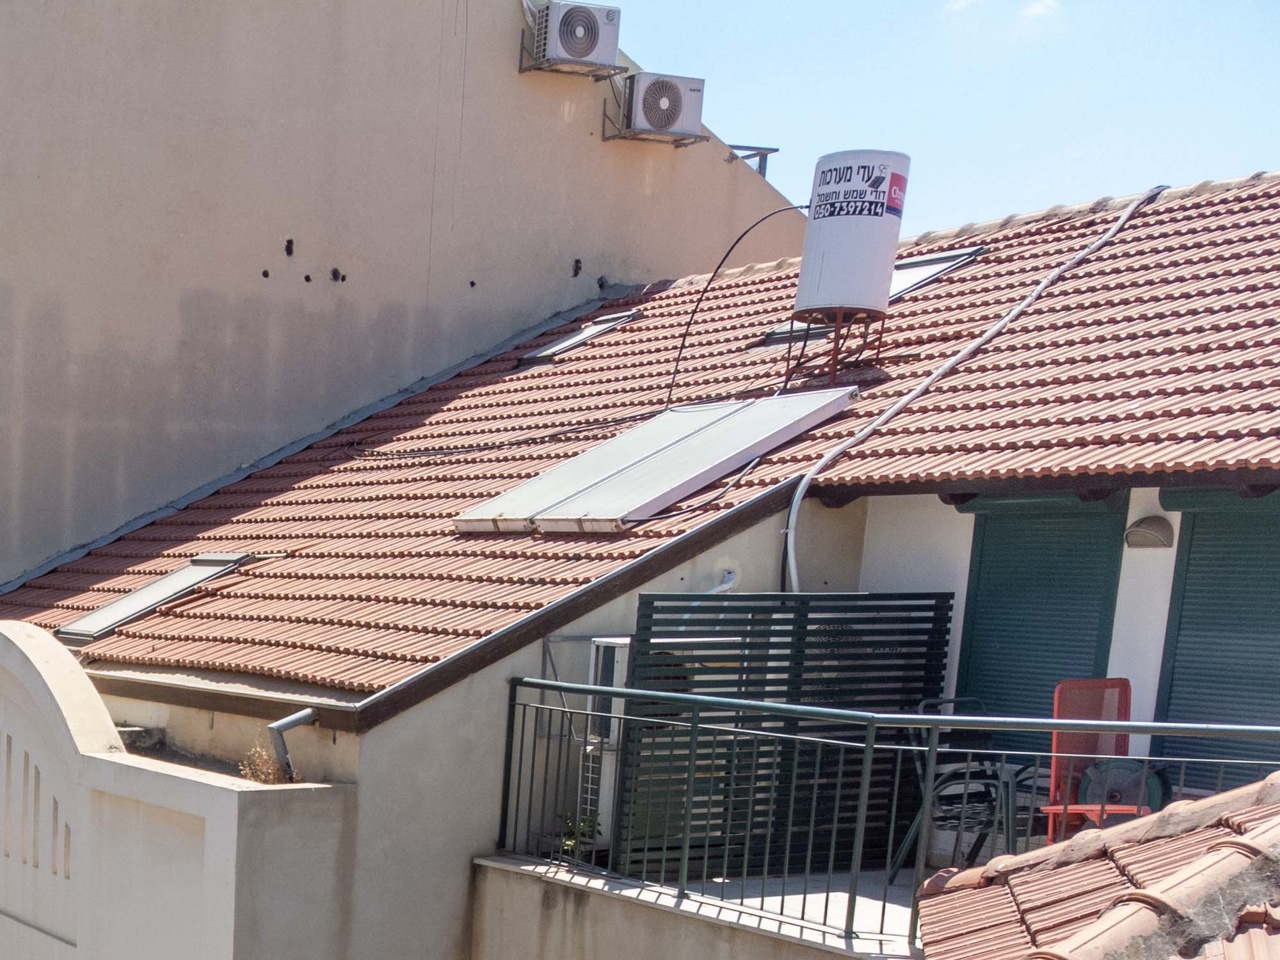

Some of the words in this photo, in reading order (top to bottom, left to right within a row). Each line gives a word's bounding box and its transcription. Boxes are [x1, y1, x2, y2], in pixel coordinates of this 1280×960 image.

[818, 166, 853, 187] מערכות
[856, 165, 875, 184] עדי
[816, 190, 841, 204] וחשמל
[843, 189, 868, 200] שמש
[870, 190, 887, 201] דודי
[814, 201, 883, 219] 050-7397214
